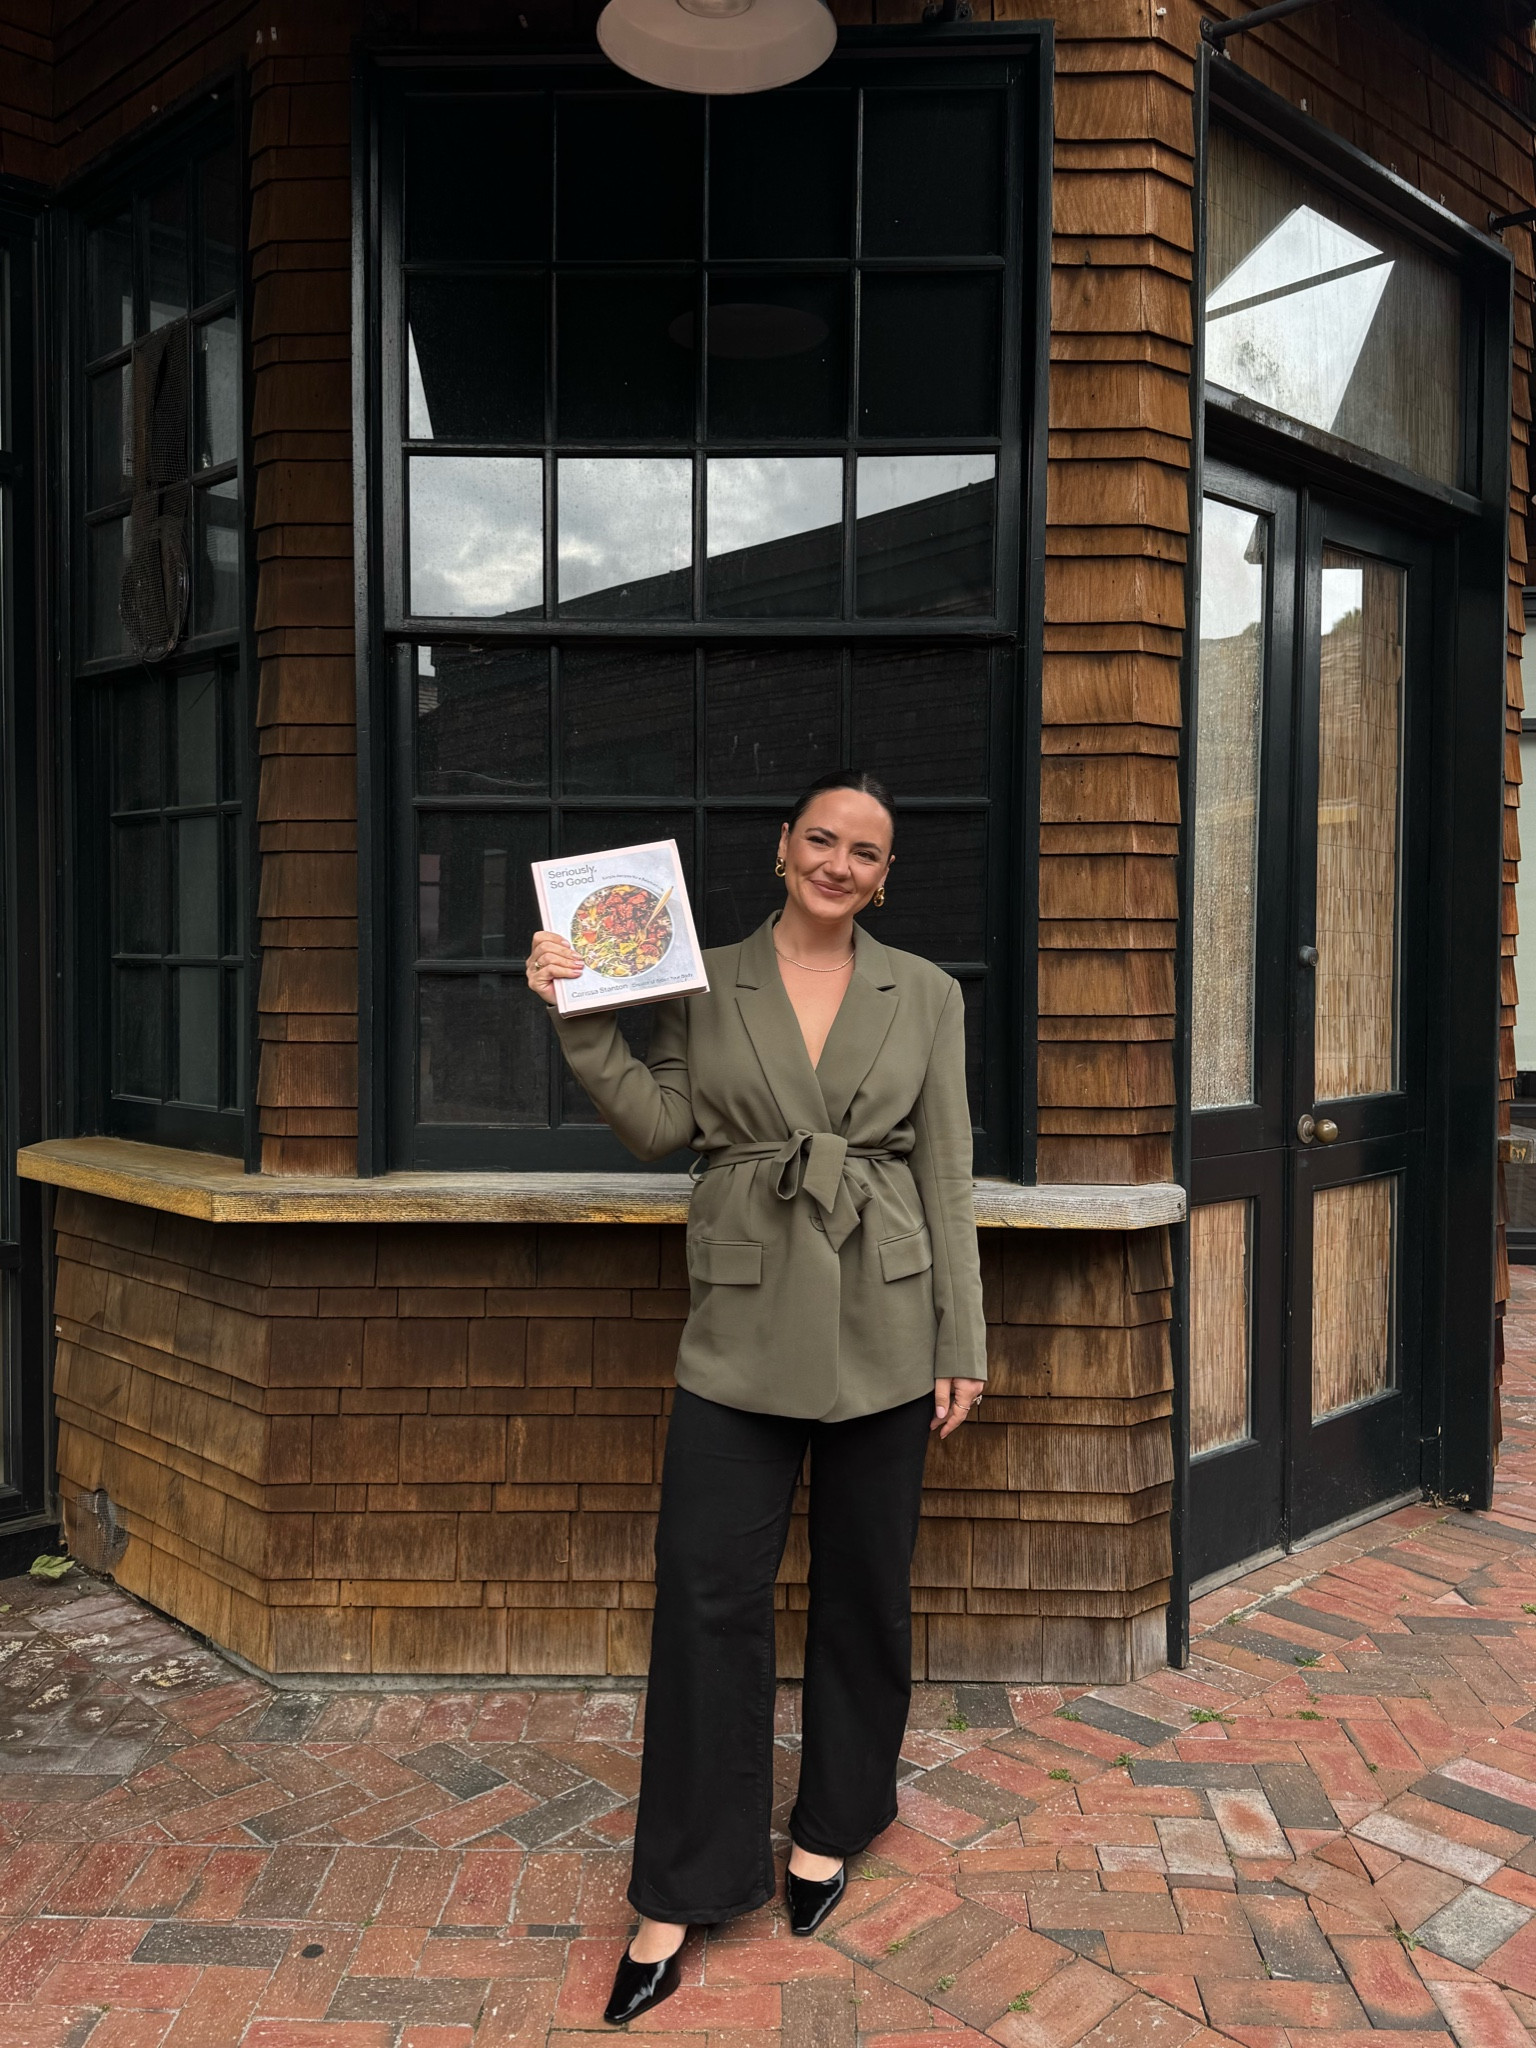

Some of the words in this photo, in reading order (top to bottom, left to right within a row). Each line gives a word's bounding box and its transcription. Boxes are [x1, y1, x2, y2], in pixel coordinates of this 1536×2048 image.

[550, 880, 564, 889] So
[566, 875, 595, 886] Good
[599, 983, 628, 993] Stanton
